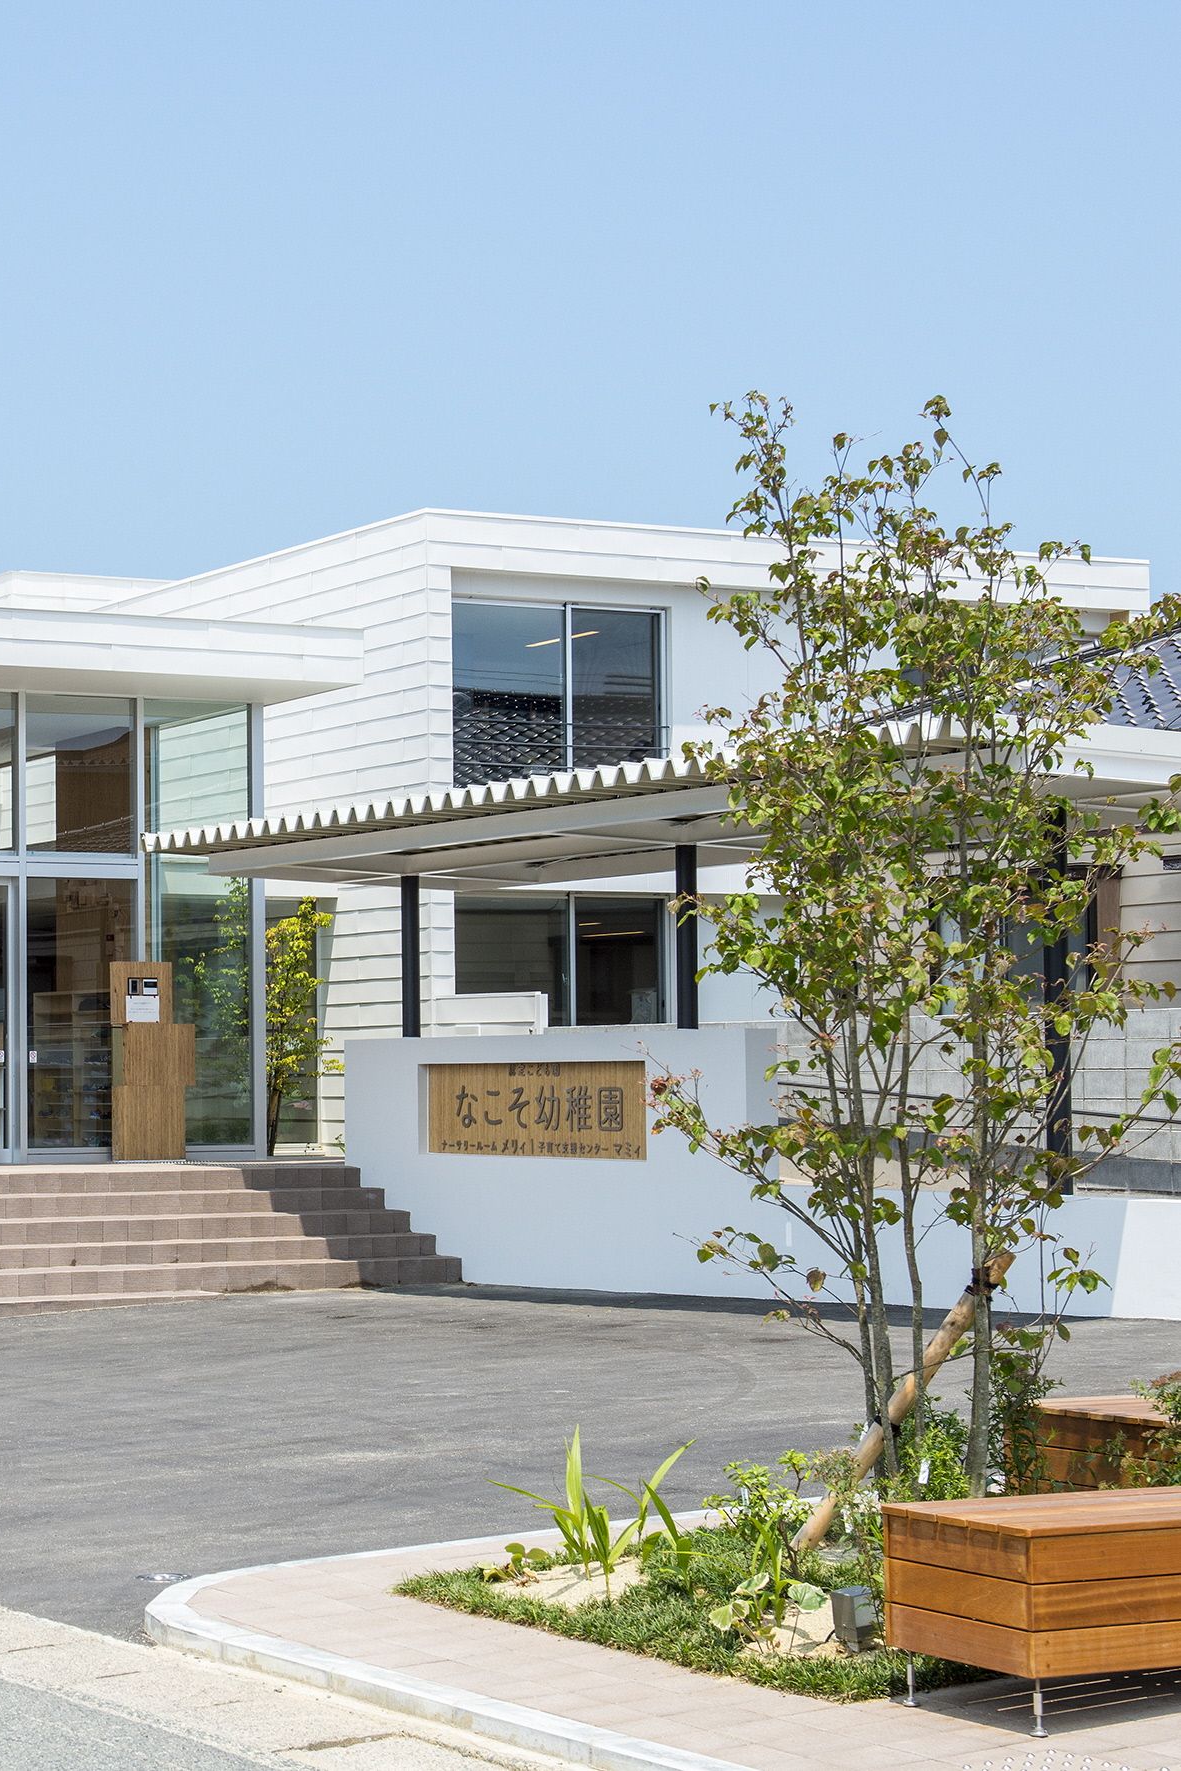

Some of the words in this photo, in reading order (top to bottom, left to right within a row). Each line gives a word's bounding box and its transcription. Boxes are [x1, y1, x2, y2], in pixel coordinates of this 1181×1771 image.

[455, 1084, 624, 1132] なこそ幼稚園
[441, 1139, 498, 1152] ナーサリールーム
[538, 1141, 609, 1155] 子育て支援センター
